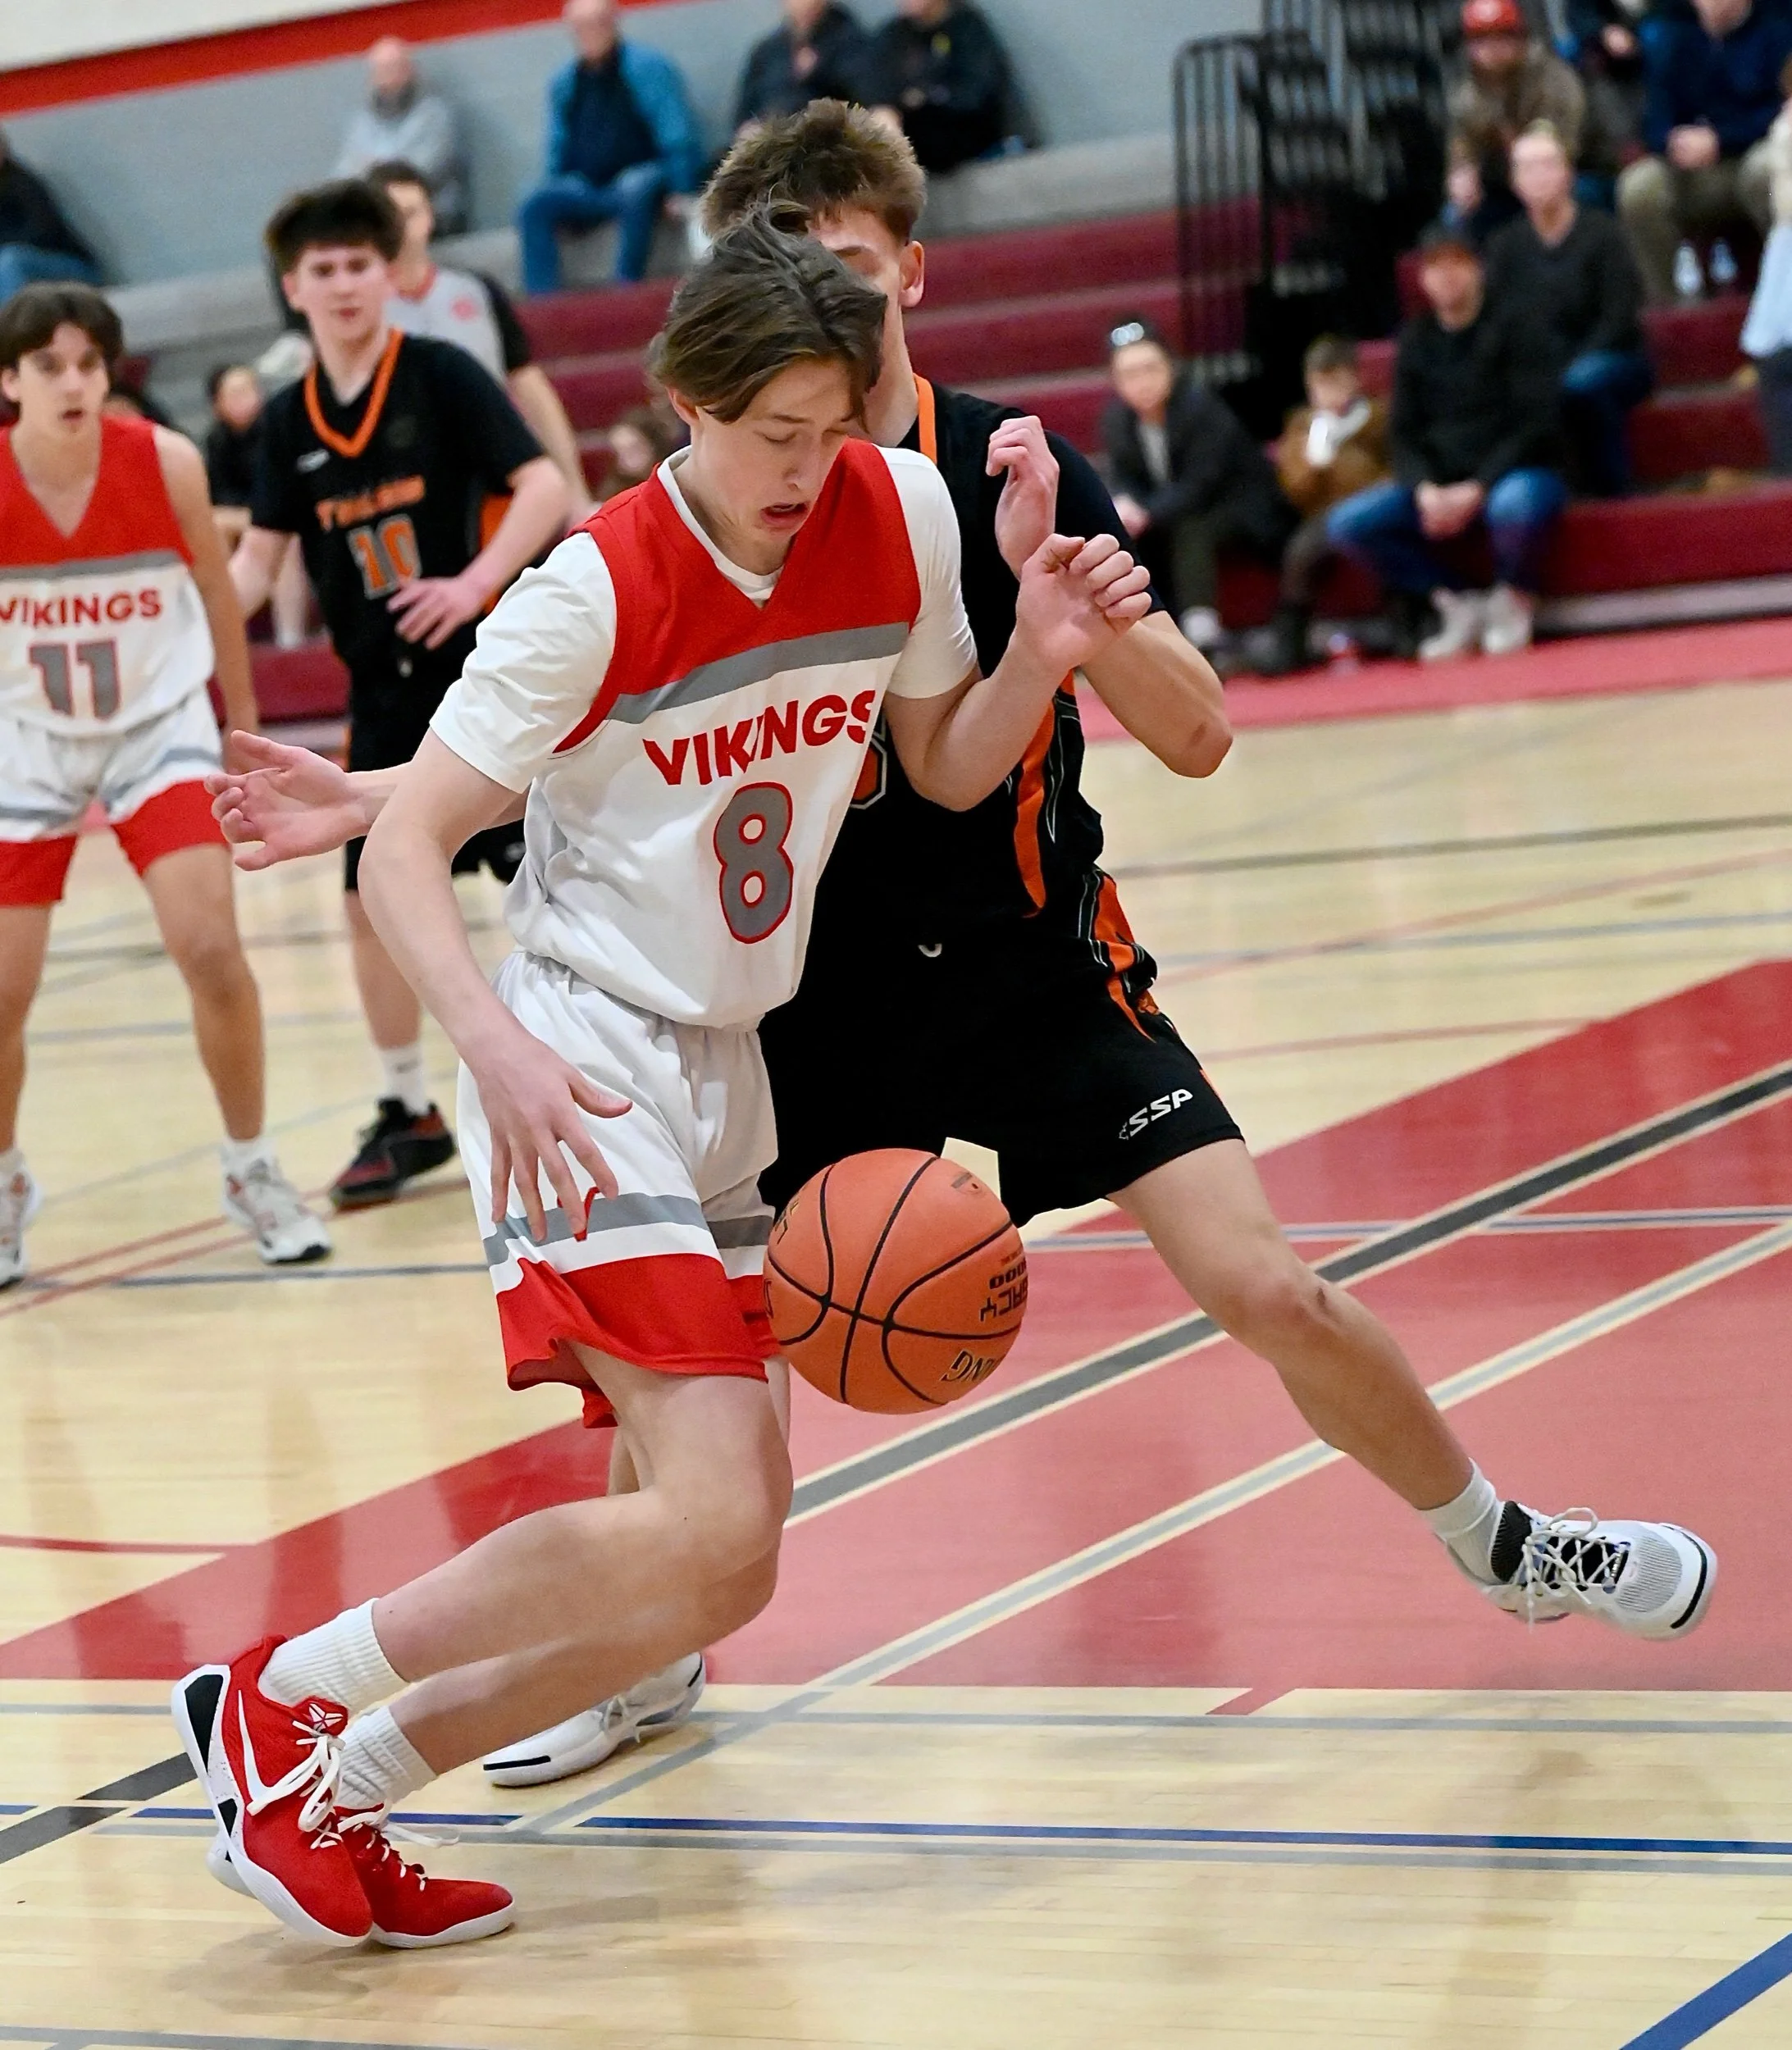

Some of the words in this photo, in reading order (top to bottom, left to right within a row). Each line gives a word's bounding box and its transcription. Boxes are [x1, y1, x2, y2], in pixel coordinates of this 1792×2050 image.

[346, 513, 422, 599] 10
[0, 588, 162, 628] VIKINGS
[28, 636, 121, 721] 11
[713, 781, 794, 944] 8
[1129, 1088, 1193, 1137] SSP
